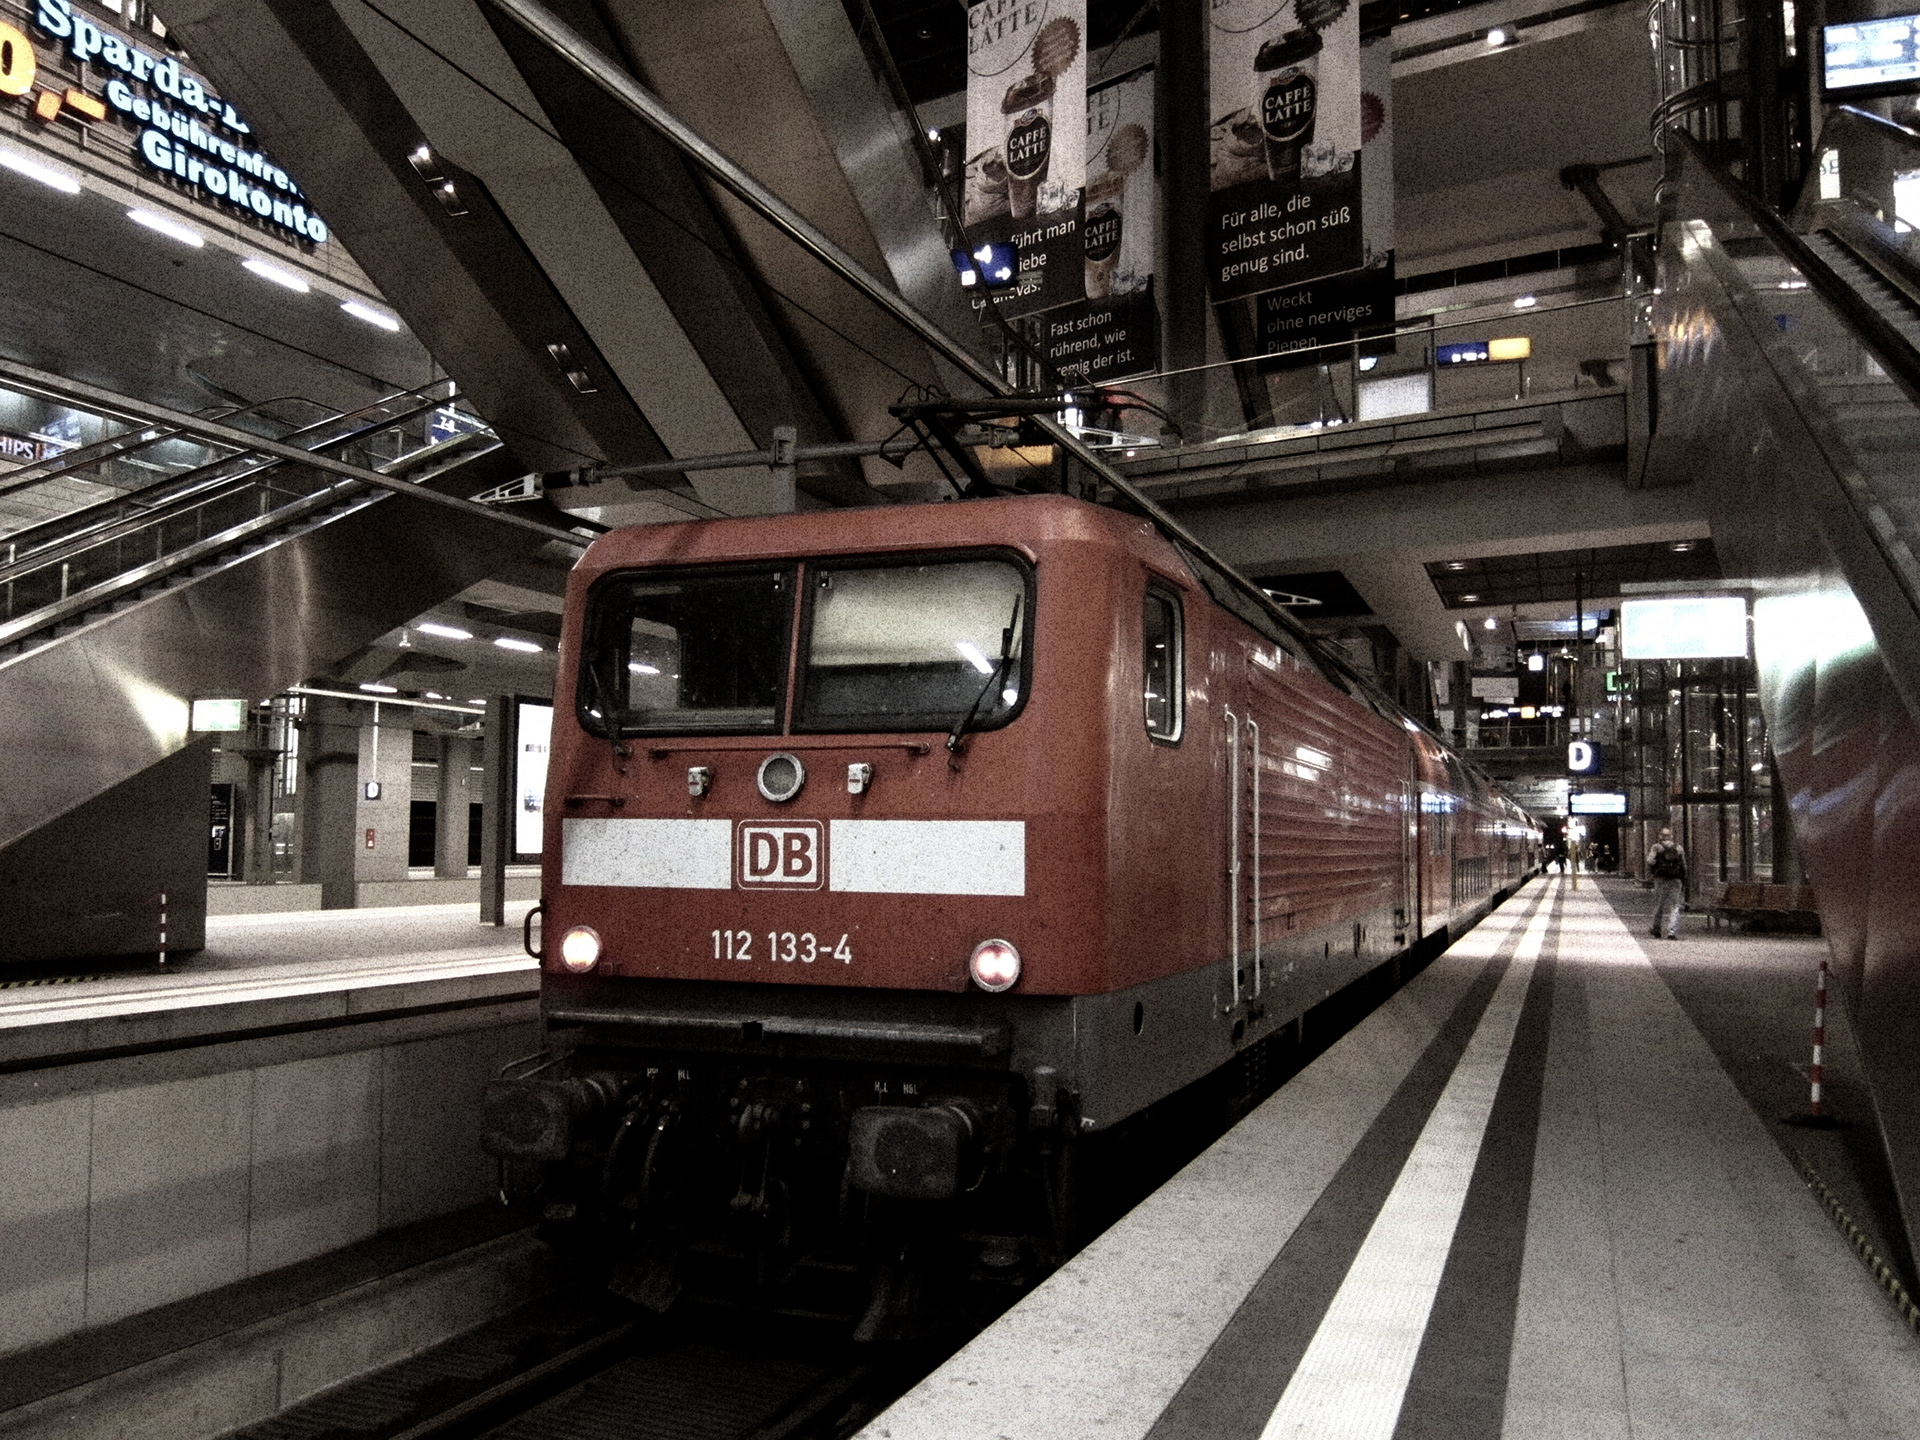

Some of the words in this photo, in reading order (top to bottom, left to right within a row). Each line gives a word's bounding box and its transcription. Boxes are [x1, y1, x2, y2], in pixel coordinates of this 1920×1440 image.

[968, 1, 1038, 55] LATTE
[1265, 99, 1313, 125] LATTE
[1009, 142, 1048, 164] LATTE
[141, 129, 328, 244] Girokonto
[1222, 211, 1248, 231] Für
[1250, 202, 1283, 223] alle,
[1286, 194, 1312, 213] die
[1046, 217, 1076, 240] man
[1084, 231, 1119, 249] LATTE
[1221, 230, 1267, 255] selbst
[1269, 218, 1317, 243] schon
[1320, 205, 1351, 229] süß
[1018, 251, 1048, 273] iebe
[1221, 255, 1269, 283] genug
[1272, 243, 1310, 267] sind.
[1266, 290, 1314, 312] Weckt
[1050, 321, 1074, 337] Fast
[1076, 310, 1112, 332] schon
[1266, 315, 1305, 334] ohne
[1307, 302, 1373, 323] nerviges
[1050, 334, 1102, 358] rührend,
[1104, 329, 1128, 346] wie
[1092, 352, 1114, 369] der
[1116, 350, 1136, 364] ist.
[1568, 741, 1593, 771] D
[748, 832, 813, 878] DB
[711, 929, 753, 961] 112
[768, 931, 852, 964] 133-4
